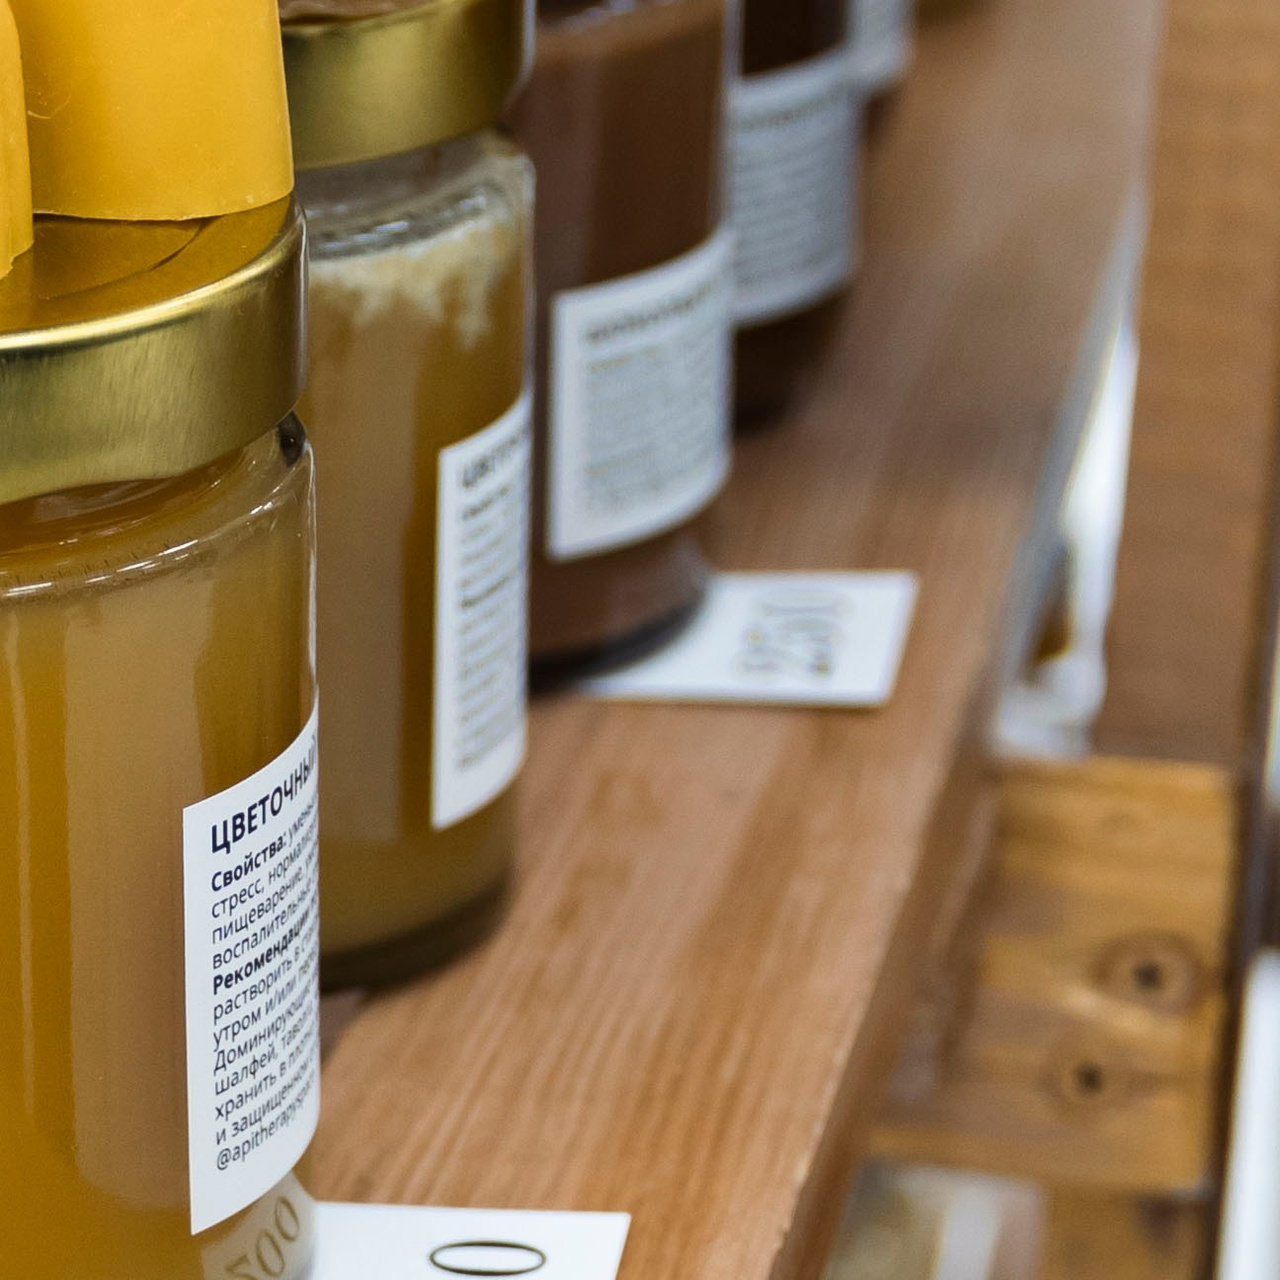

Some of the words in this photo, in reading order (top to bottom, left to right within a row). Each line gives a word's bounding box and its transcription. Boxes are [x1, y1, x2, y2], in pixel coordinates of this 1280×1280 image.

[211, 831, 287, 892] Свойства:
[211, 878, 265, 919] стресс,
[213, 906, 310, 996] Рекомендации
[213, 958, 293, 1026] растворить
[213, 1006, 262, 1053] утром
[265, 975, 297, 1016] и/или
[214, 1041, 279, 1096] шалфей,
[215, 1072, 278, 1122] хранить
[279, 1063, 287, 1078] в
[215, 1128, 227, 1146] и
